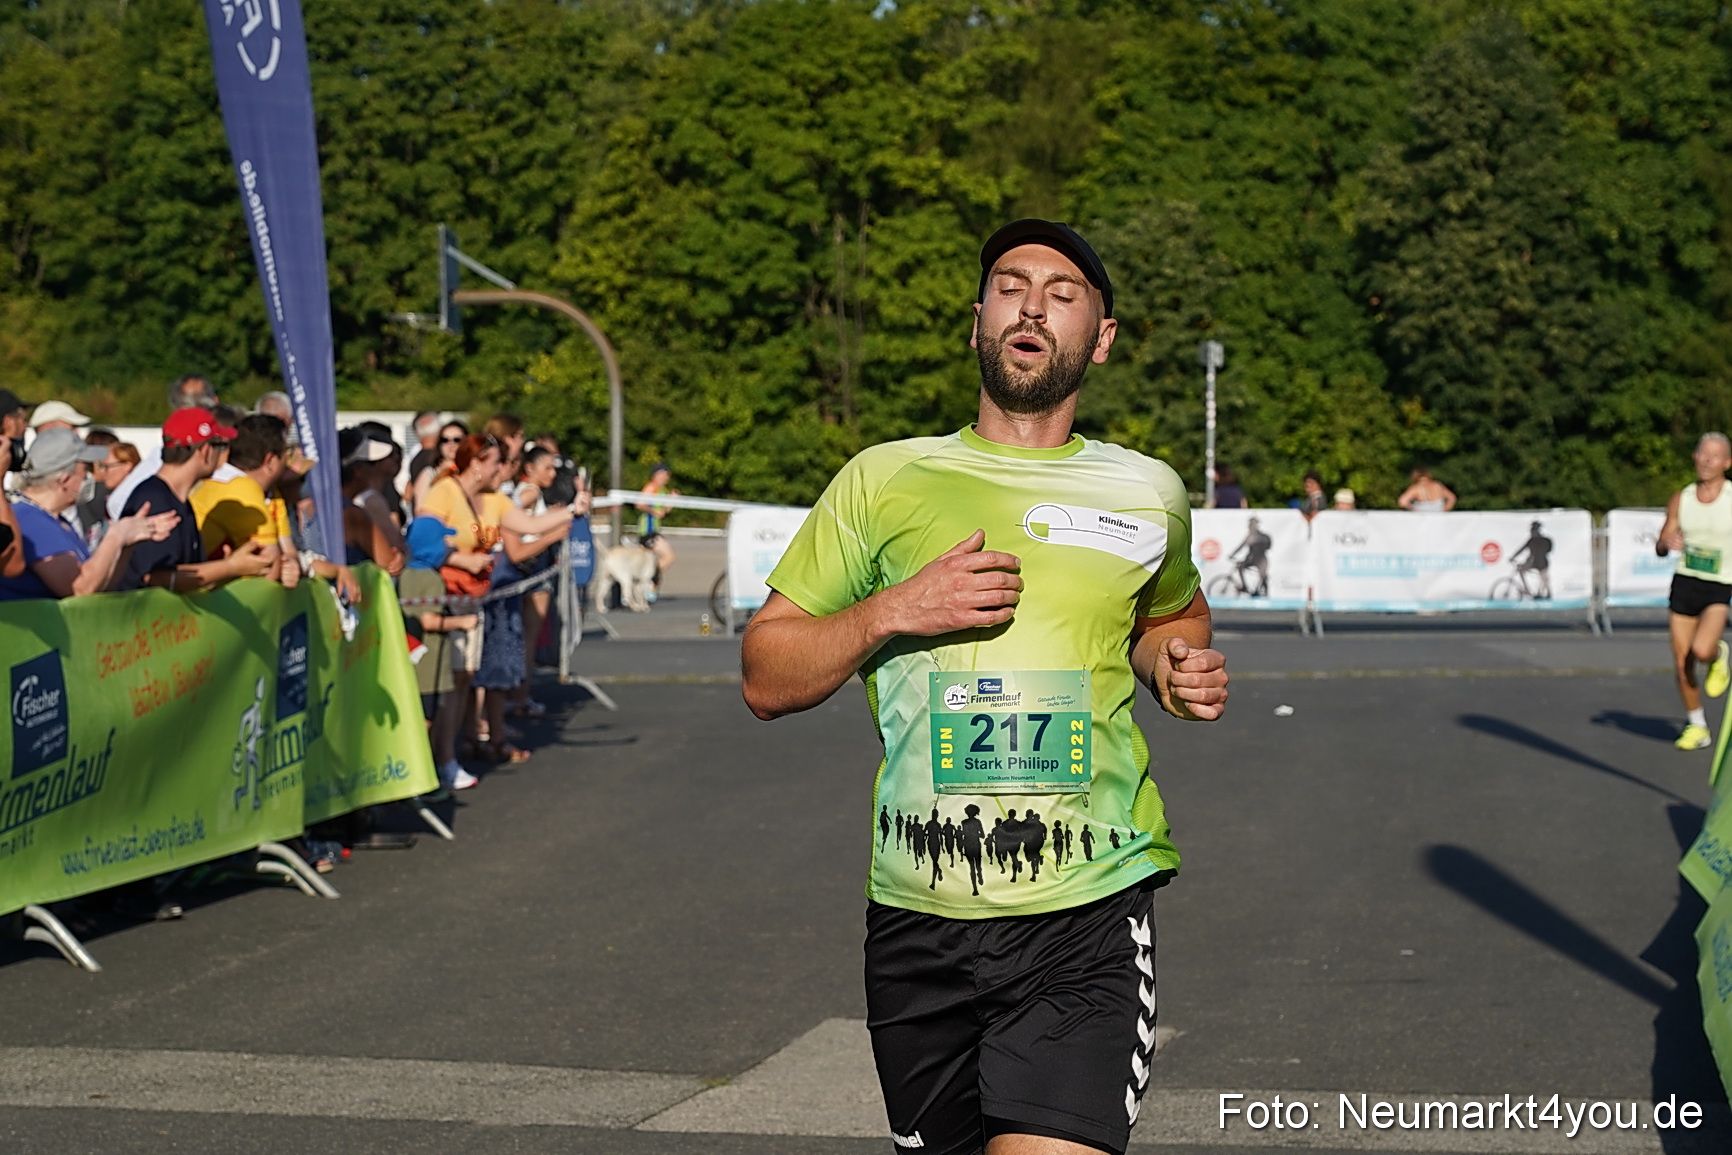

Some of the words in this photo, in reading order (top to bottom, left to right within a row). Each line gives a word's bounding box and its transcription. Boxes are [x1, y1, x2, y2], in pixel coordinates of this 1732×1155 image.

[1098, 515, 1139, 531] Klinikum
[1098, 524, 1136, 540] Neumarkt
[22, 688, 61, 718] Fischer
[970, 691, 1022, 704] Firmenlauf
[969, 713, 1053, 753] 217
[1070, 720, 1084, 775] 2022
[939, 728, 954, 769] RUN
[964, 757, 1003, 770] Stark
[1007, 757, 1060, 772] Philipp
[0, 727, 116, 834] rmenlauf
